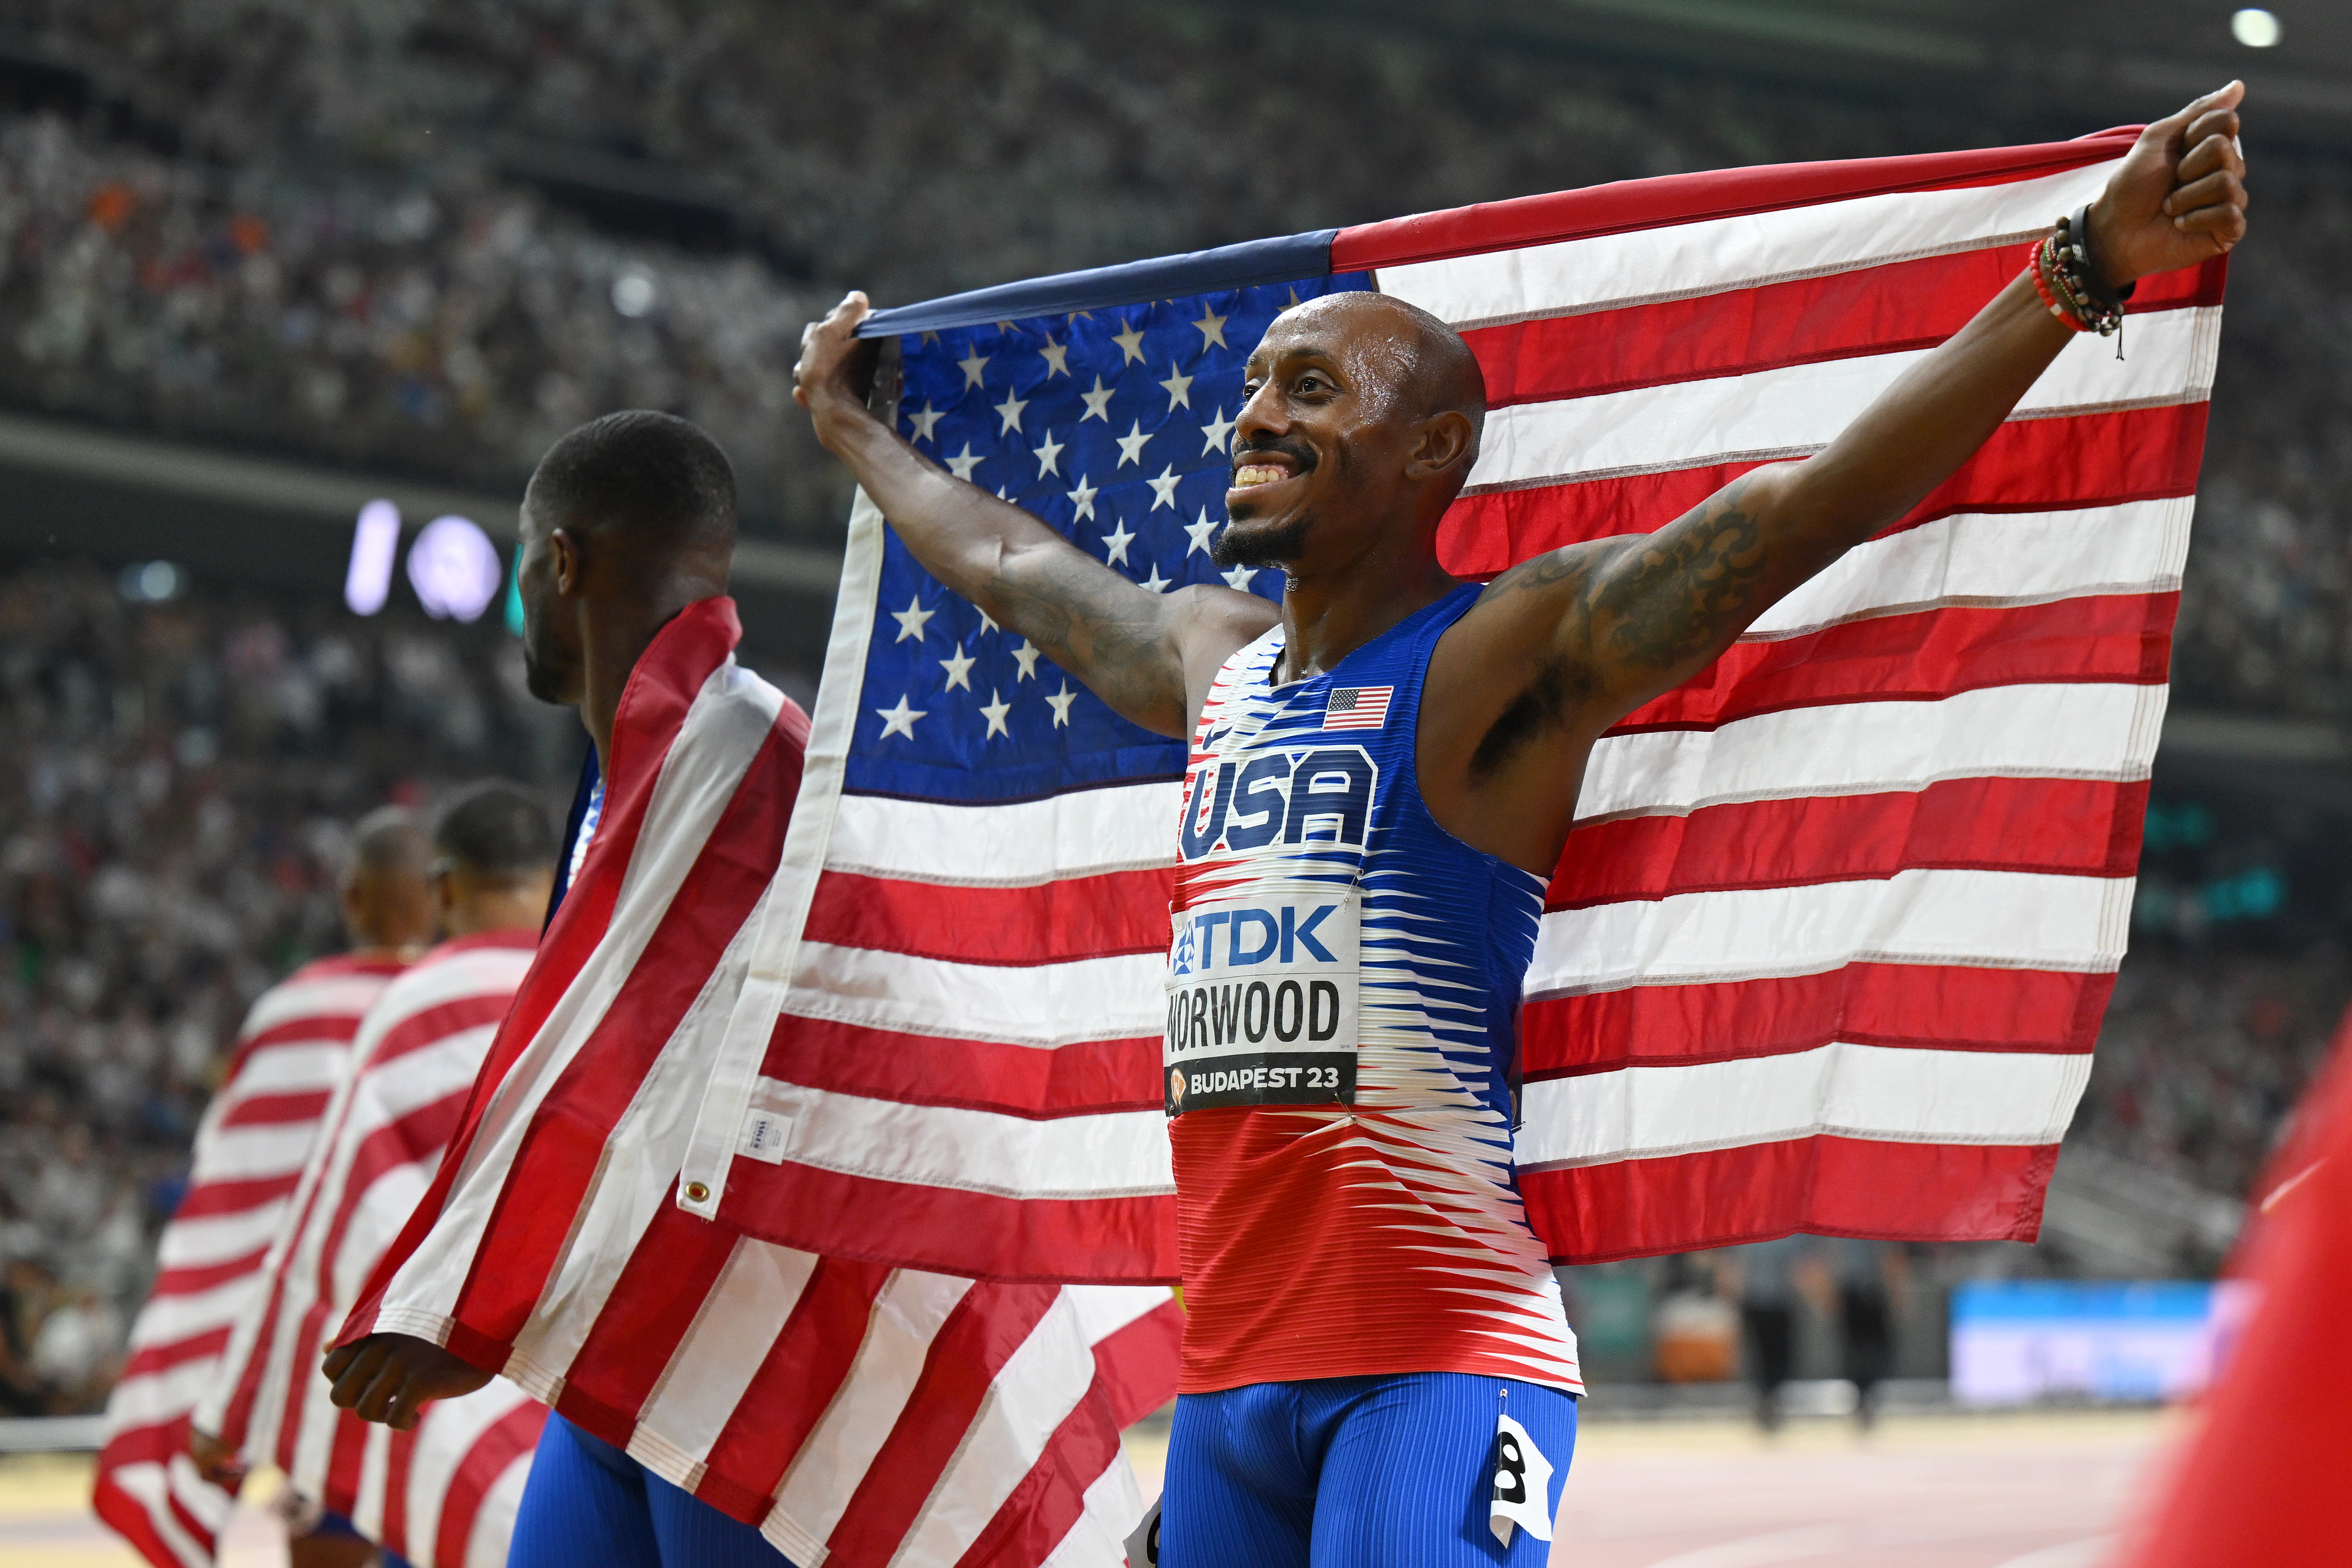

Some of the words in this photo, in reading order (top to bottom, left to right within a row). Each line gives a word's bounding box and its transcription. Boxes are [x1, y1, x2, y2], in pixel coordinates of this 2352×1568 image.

[1178, 745, 1378, 862] USA
[1195, 905, 1338, 969] TDK
[1191, 1068, 1303, 1095] BUDAPEST
[1307, 1067, 1339, 1088] 23
